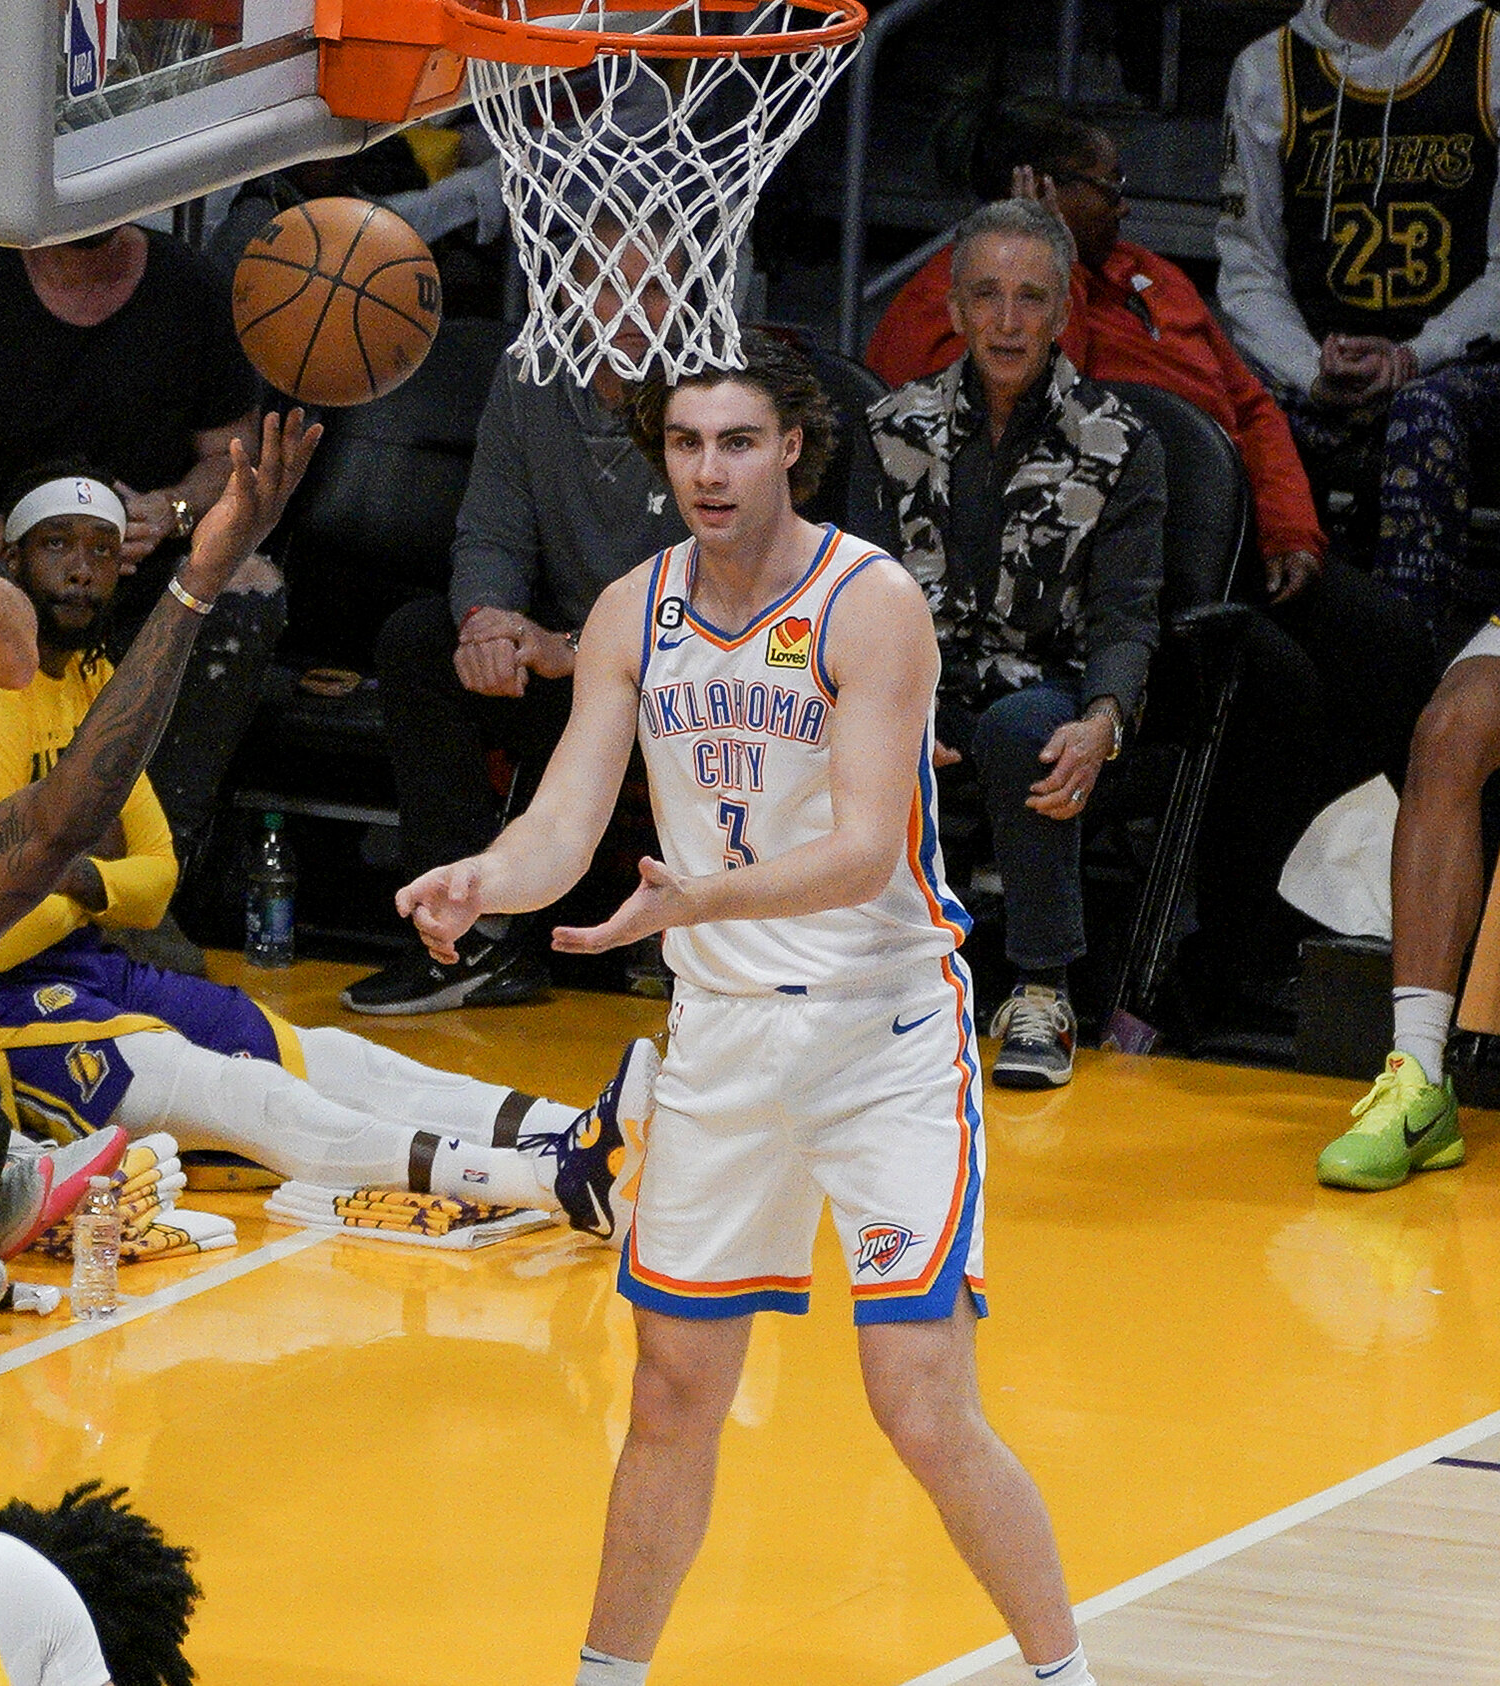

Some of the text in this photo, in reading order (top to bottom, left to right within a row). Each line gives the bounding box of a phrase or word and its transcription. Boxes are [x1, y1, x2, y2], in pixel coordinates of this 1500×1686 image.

[73, 50, 92, 87] NBA
[1296, 129, 1475, 198] LAKERS
[1326, 202, 1451, 311] 23
[660, 601, 682, 625] 6
[640, 680, 830, 744] OKLAHOMA
[693, 738, 767, 792] CITY
